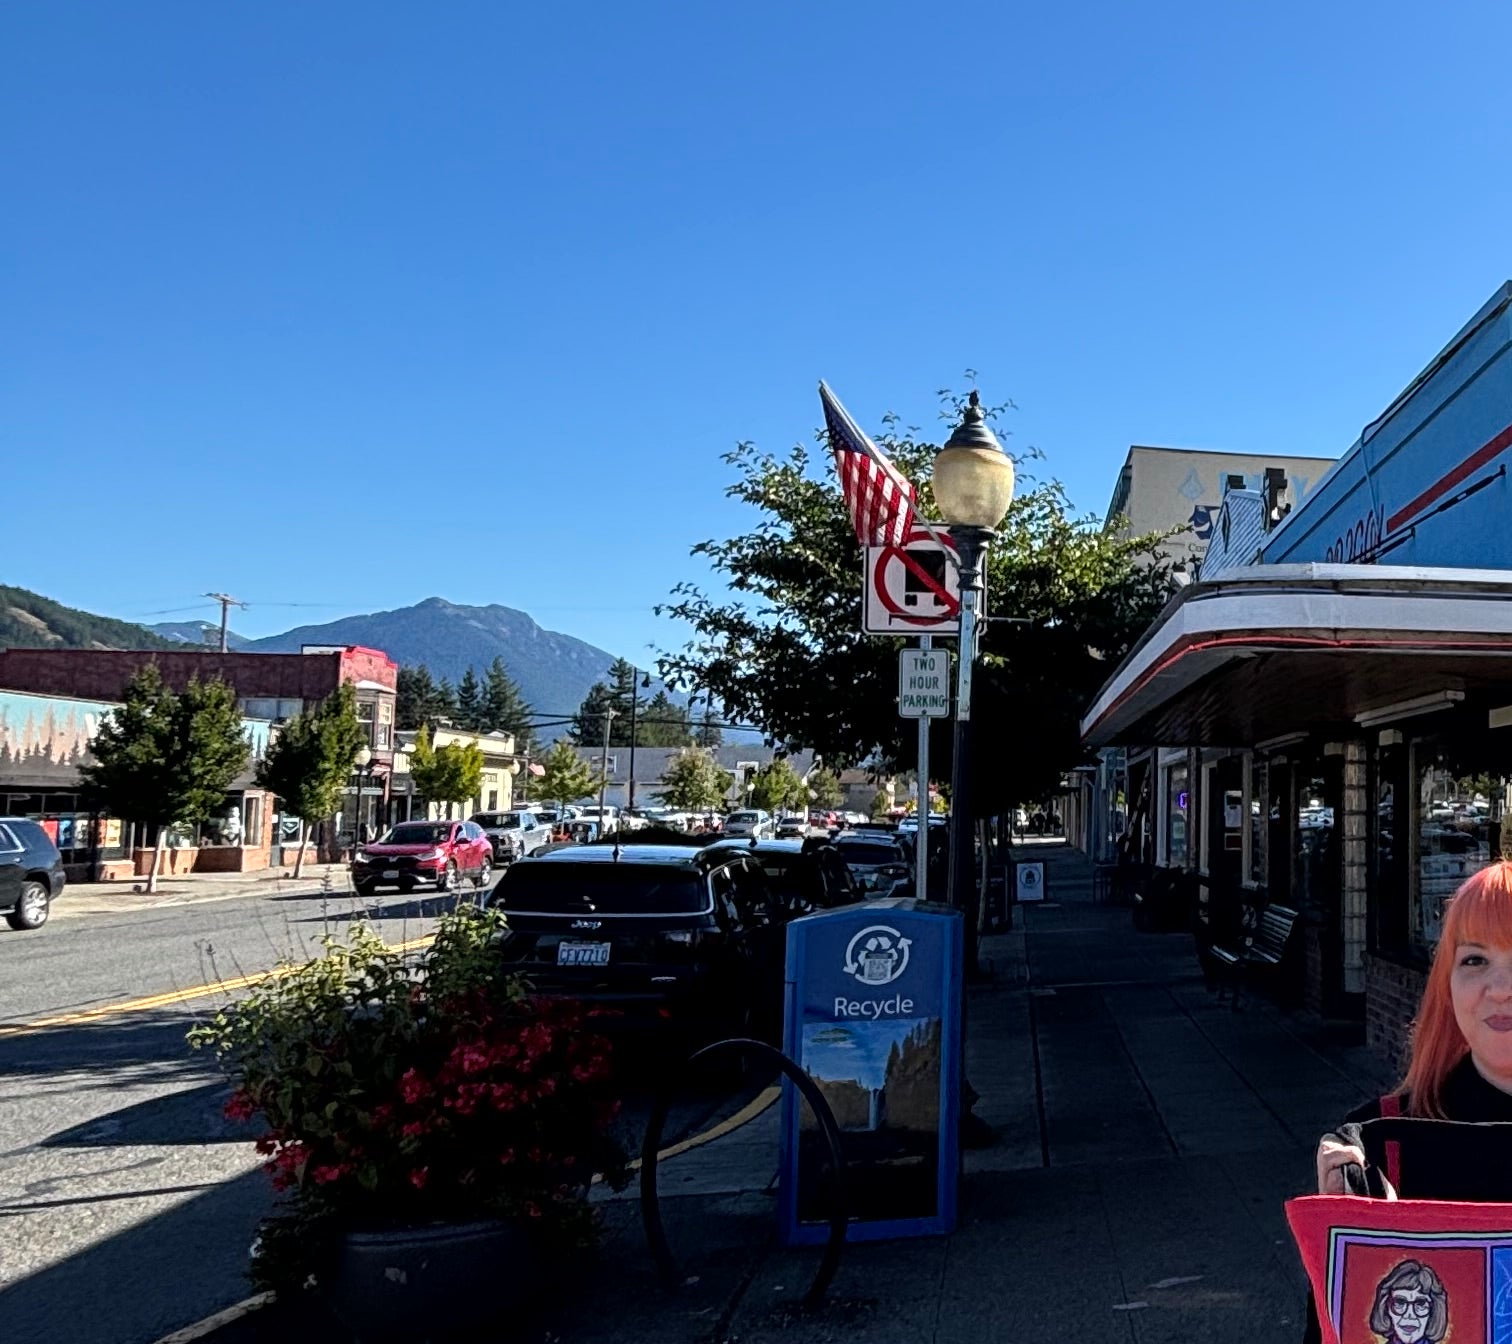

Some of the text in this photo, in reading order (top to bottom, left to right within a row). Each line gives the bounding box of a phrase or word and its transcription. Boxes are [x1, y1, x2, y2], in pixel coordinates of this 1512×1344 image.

[913, 657, 936, 671] TWO
[909, 676, 939, 690] HOUR
[903, 694, 946, 708] PARKING
[571, 919, 602, 930] Jeep
[834, 994, 914, 1020] Recycle
